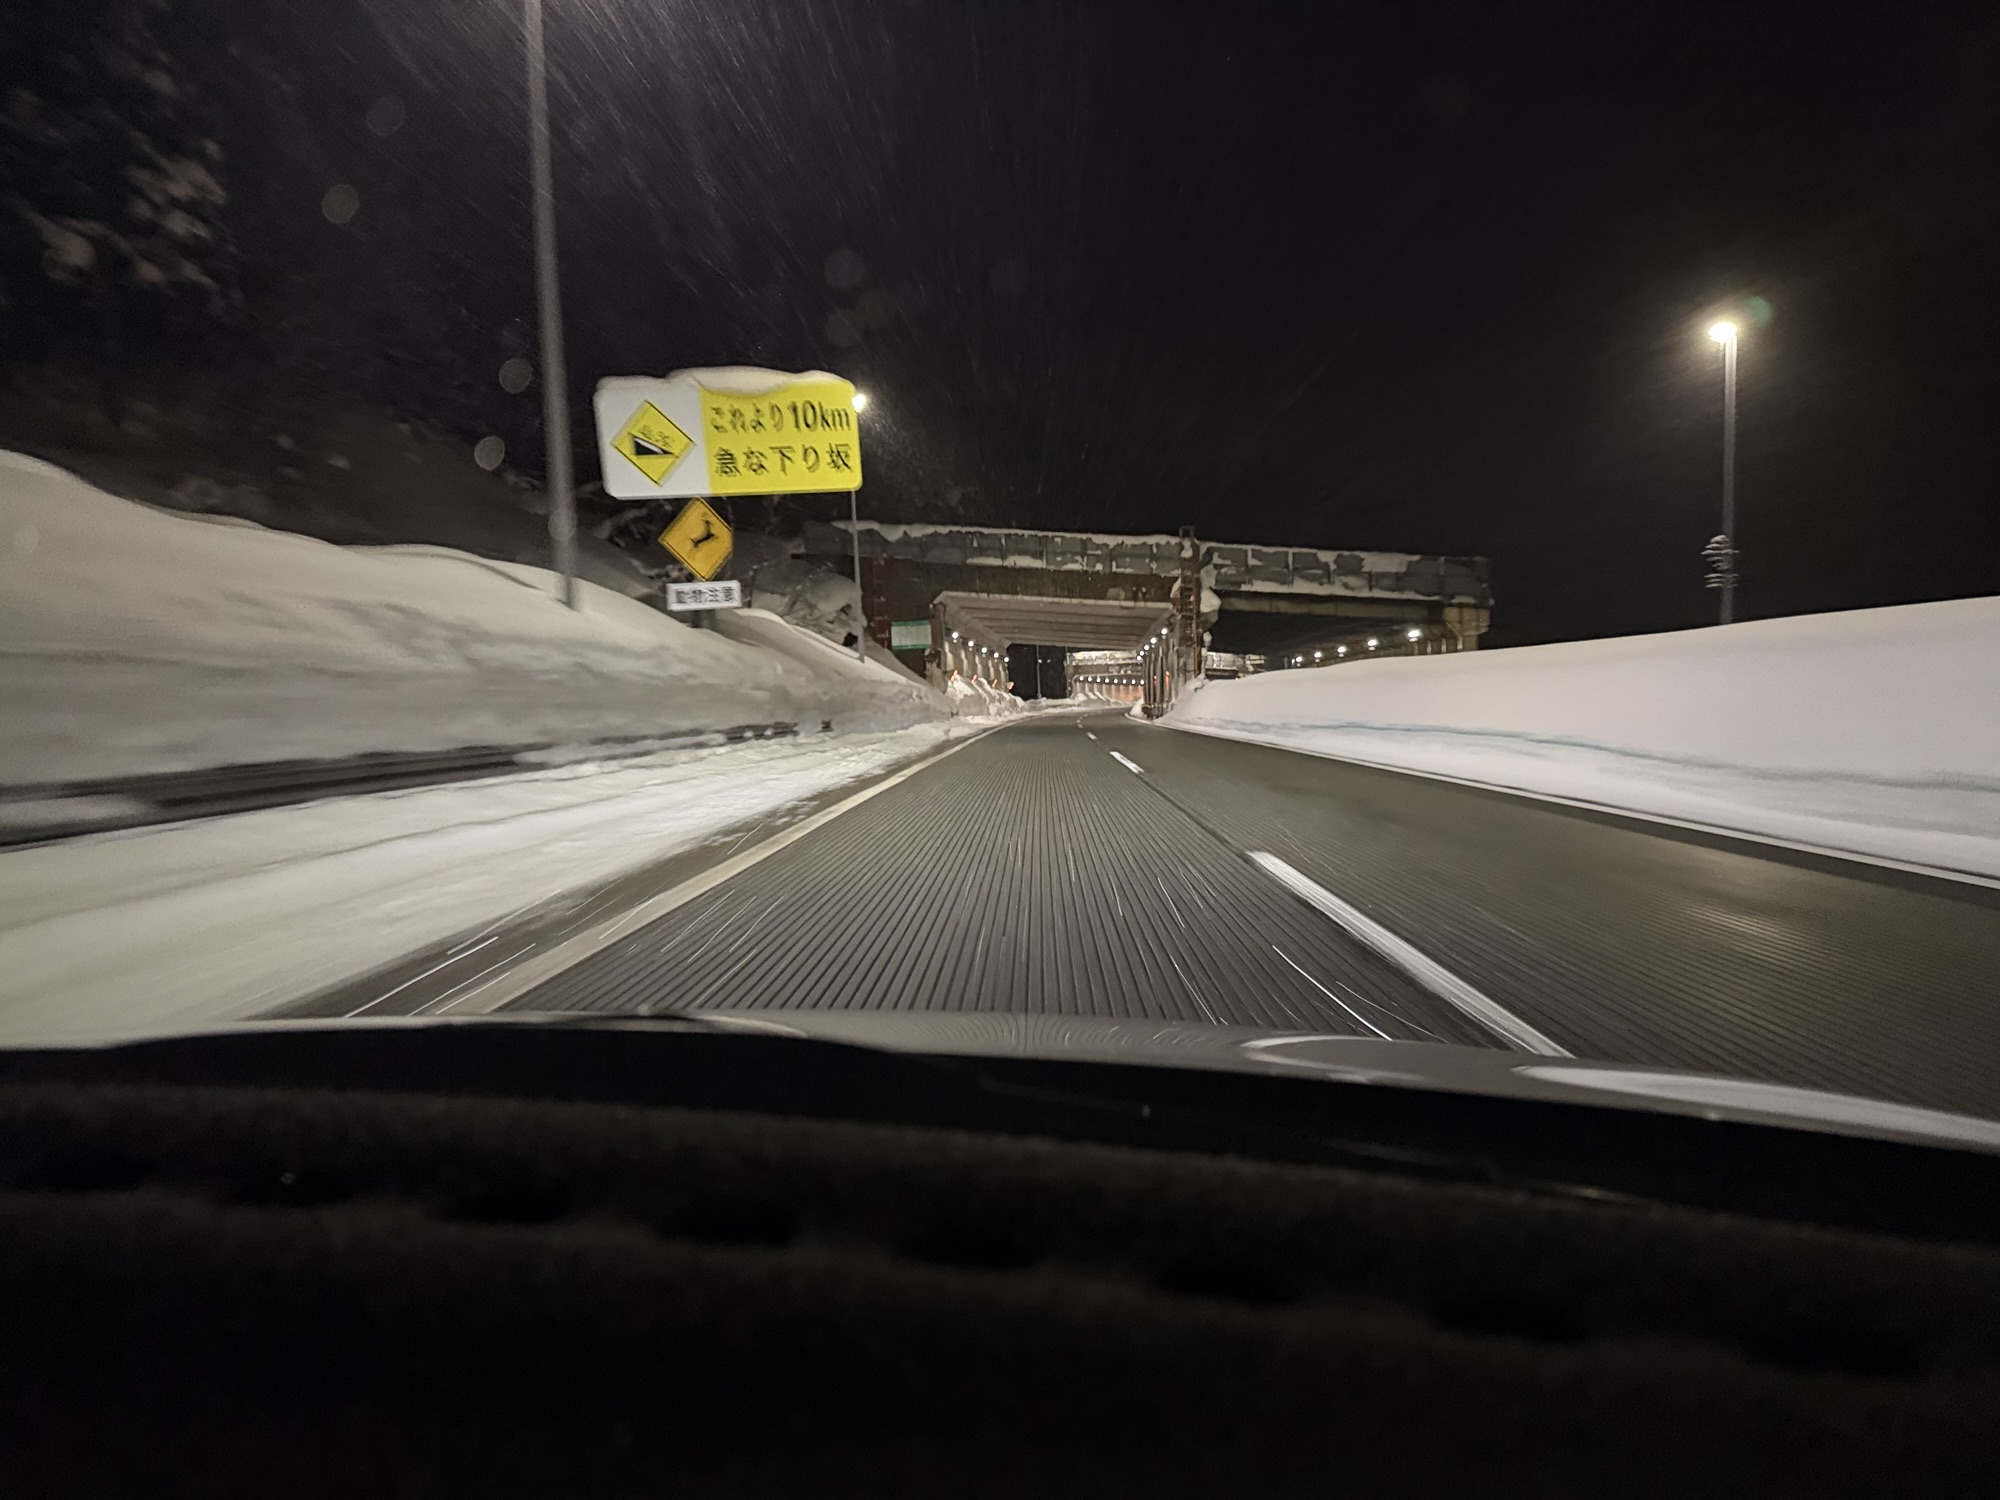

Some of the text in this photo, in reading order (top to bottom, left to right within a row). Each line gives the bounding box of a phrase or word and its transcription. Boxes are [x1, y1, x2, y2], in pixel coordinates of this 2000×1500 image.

[711, 400, 851, 433] これより10km
[714, 442, 854, 478] 急な下り坂
